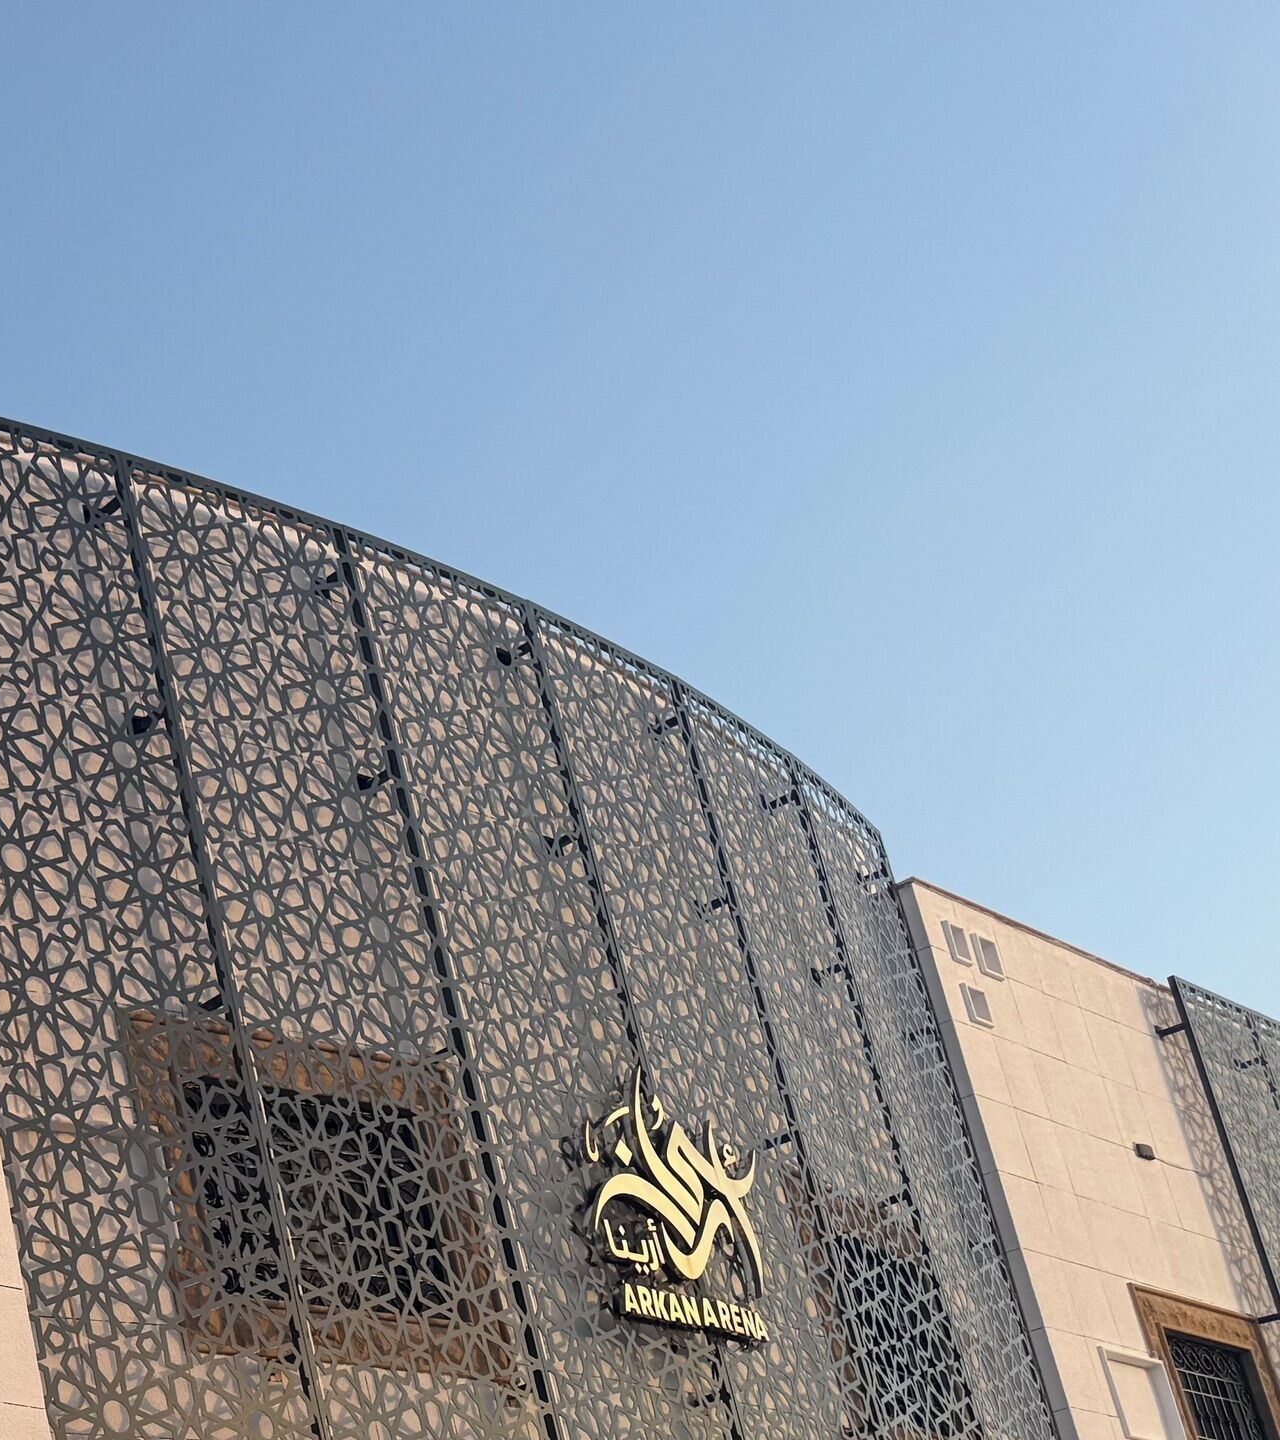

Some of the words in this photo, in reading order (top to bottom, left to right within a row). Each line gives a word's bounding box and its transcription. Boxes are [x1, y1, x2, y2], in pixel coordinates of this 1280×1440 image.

[603, 1218, 666, 1276] أرينا
[624, 1283, 702, 1327] ARKAN
[702, 1297, 771, 1342] ARENA
